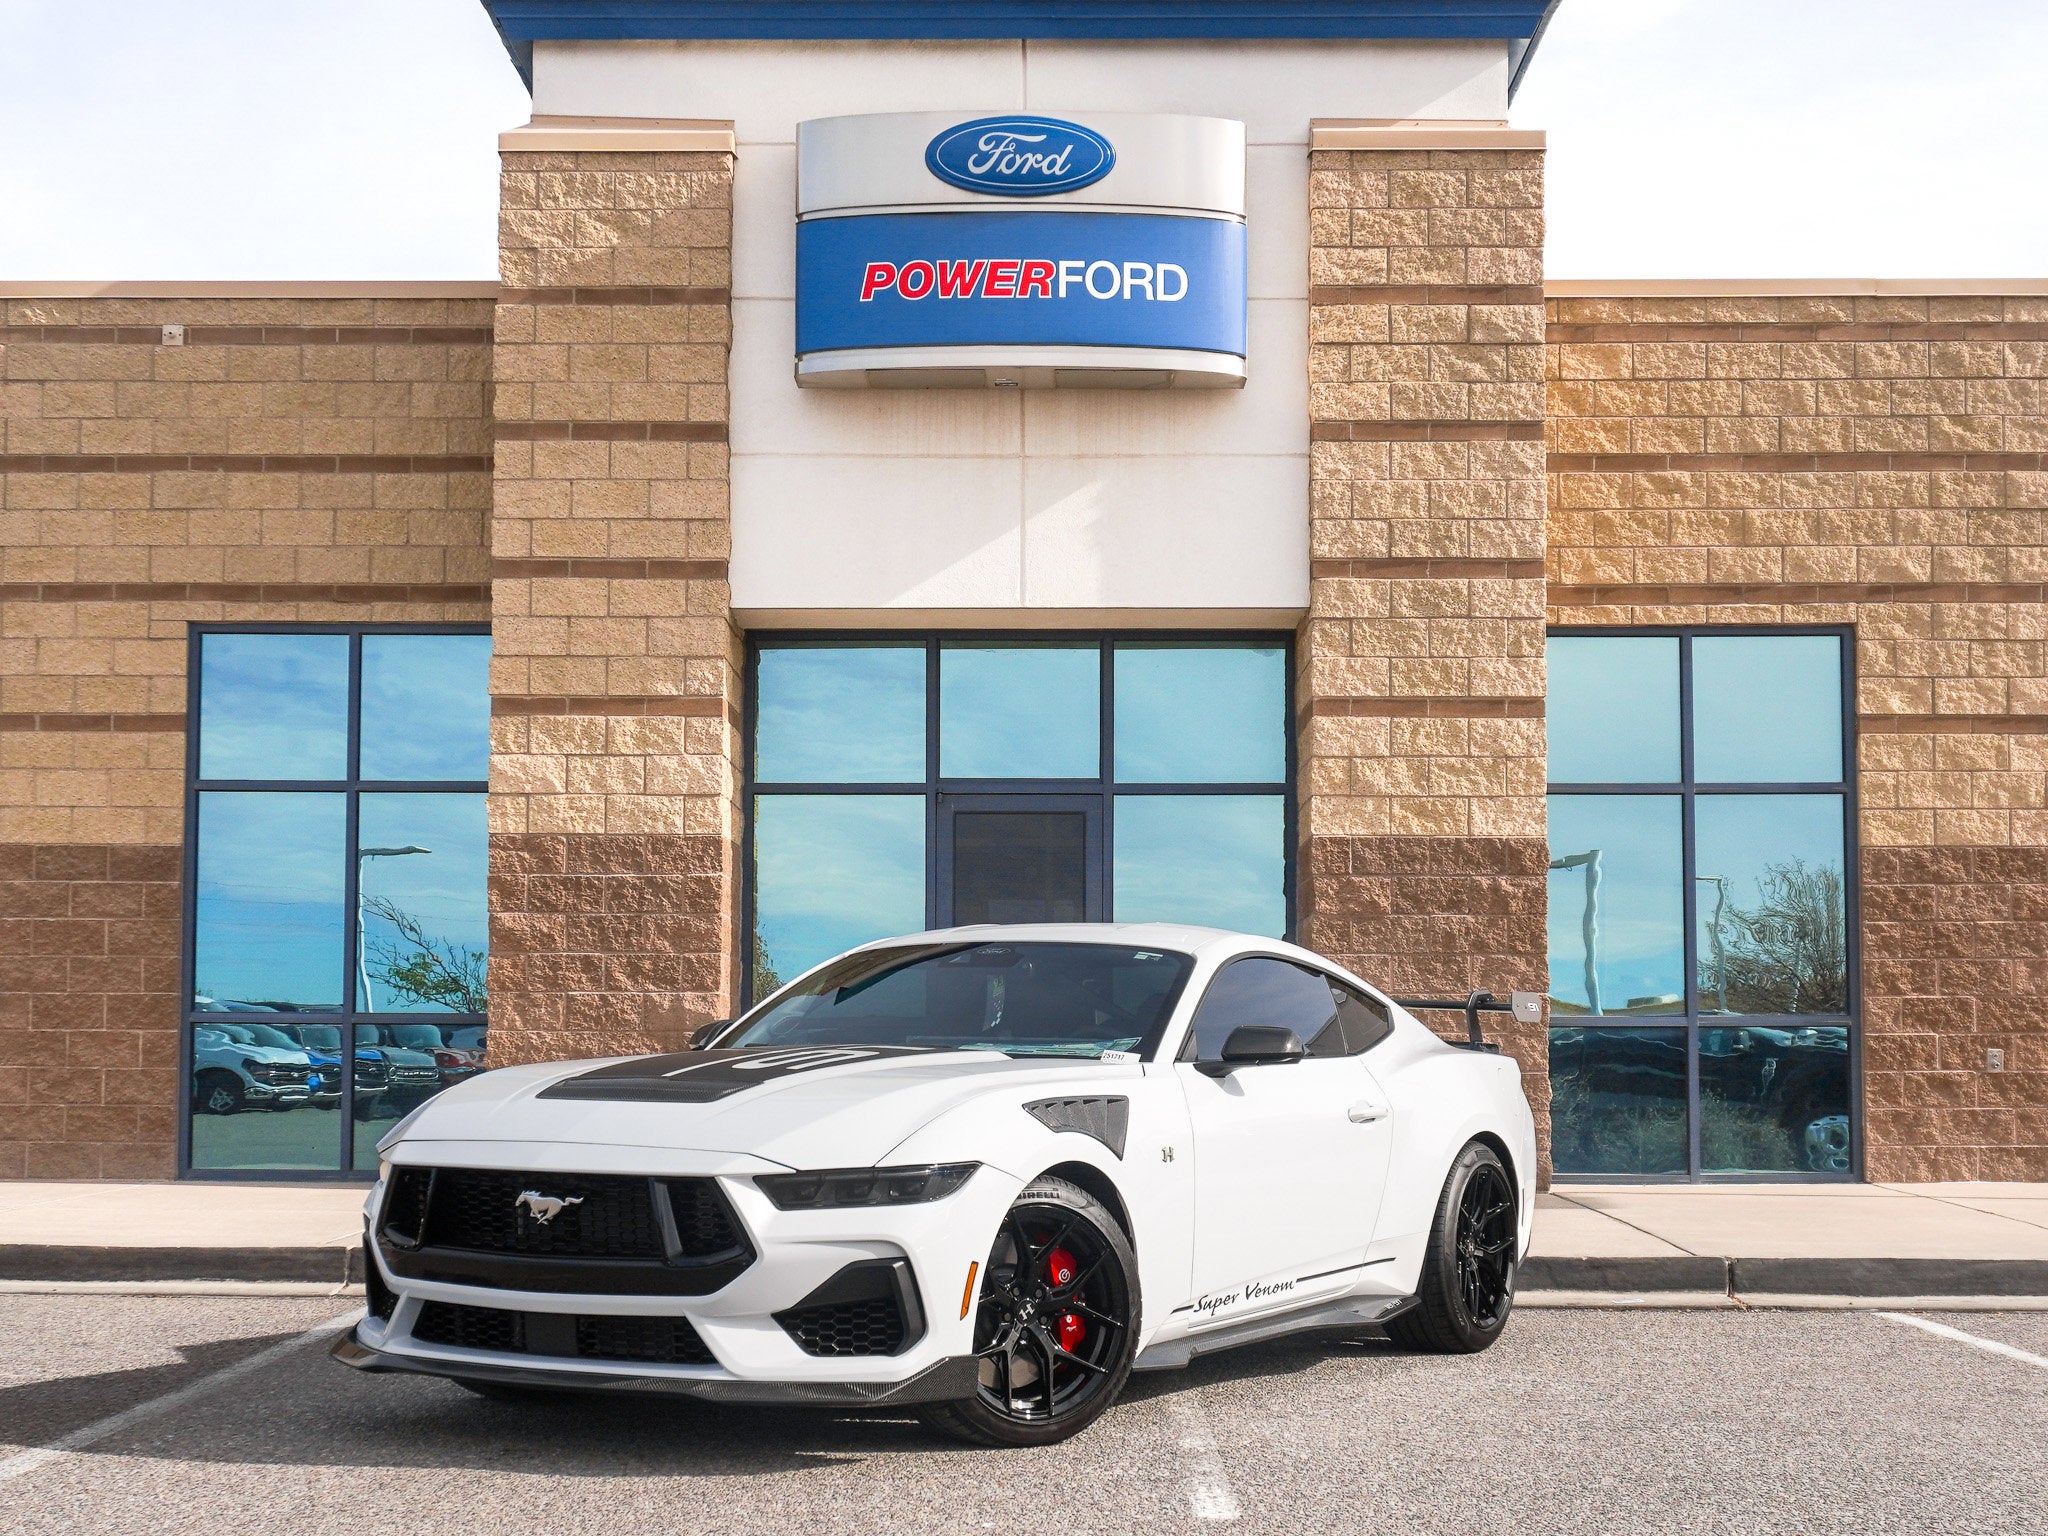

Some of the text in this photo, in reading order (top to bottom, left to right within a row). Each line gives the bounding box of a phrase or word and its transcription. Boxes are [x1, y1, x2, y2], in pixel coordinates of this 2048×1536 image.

[967, 131, 1072, 176] Ford
[1193, 1282, 1295, 1317] Super Venom
